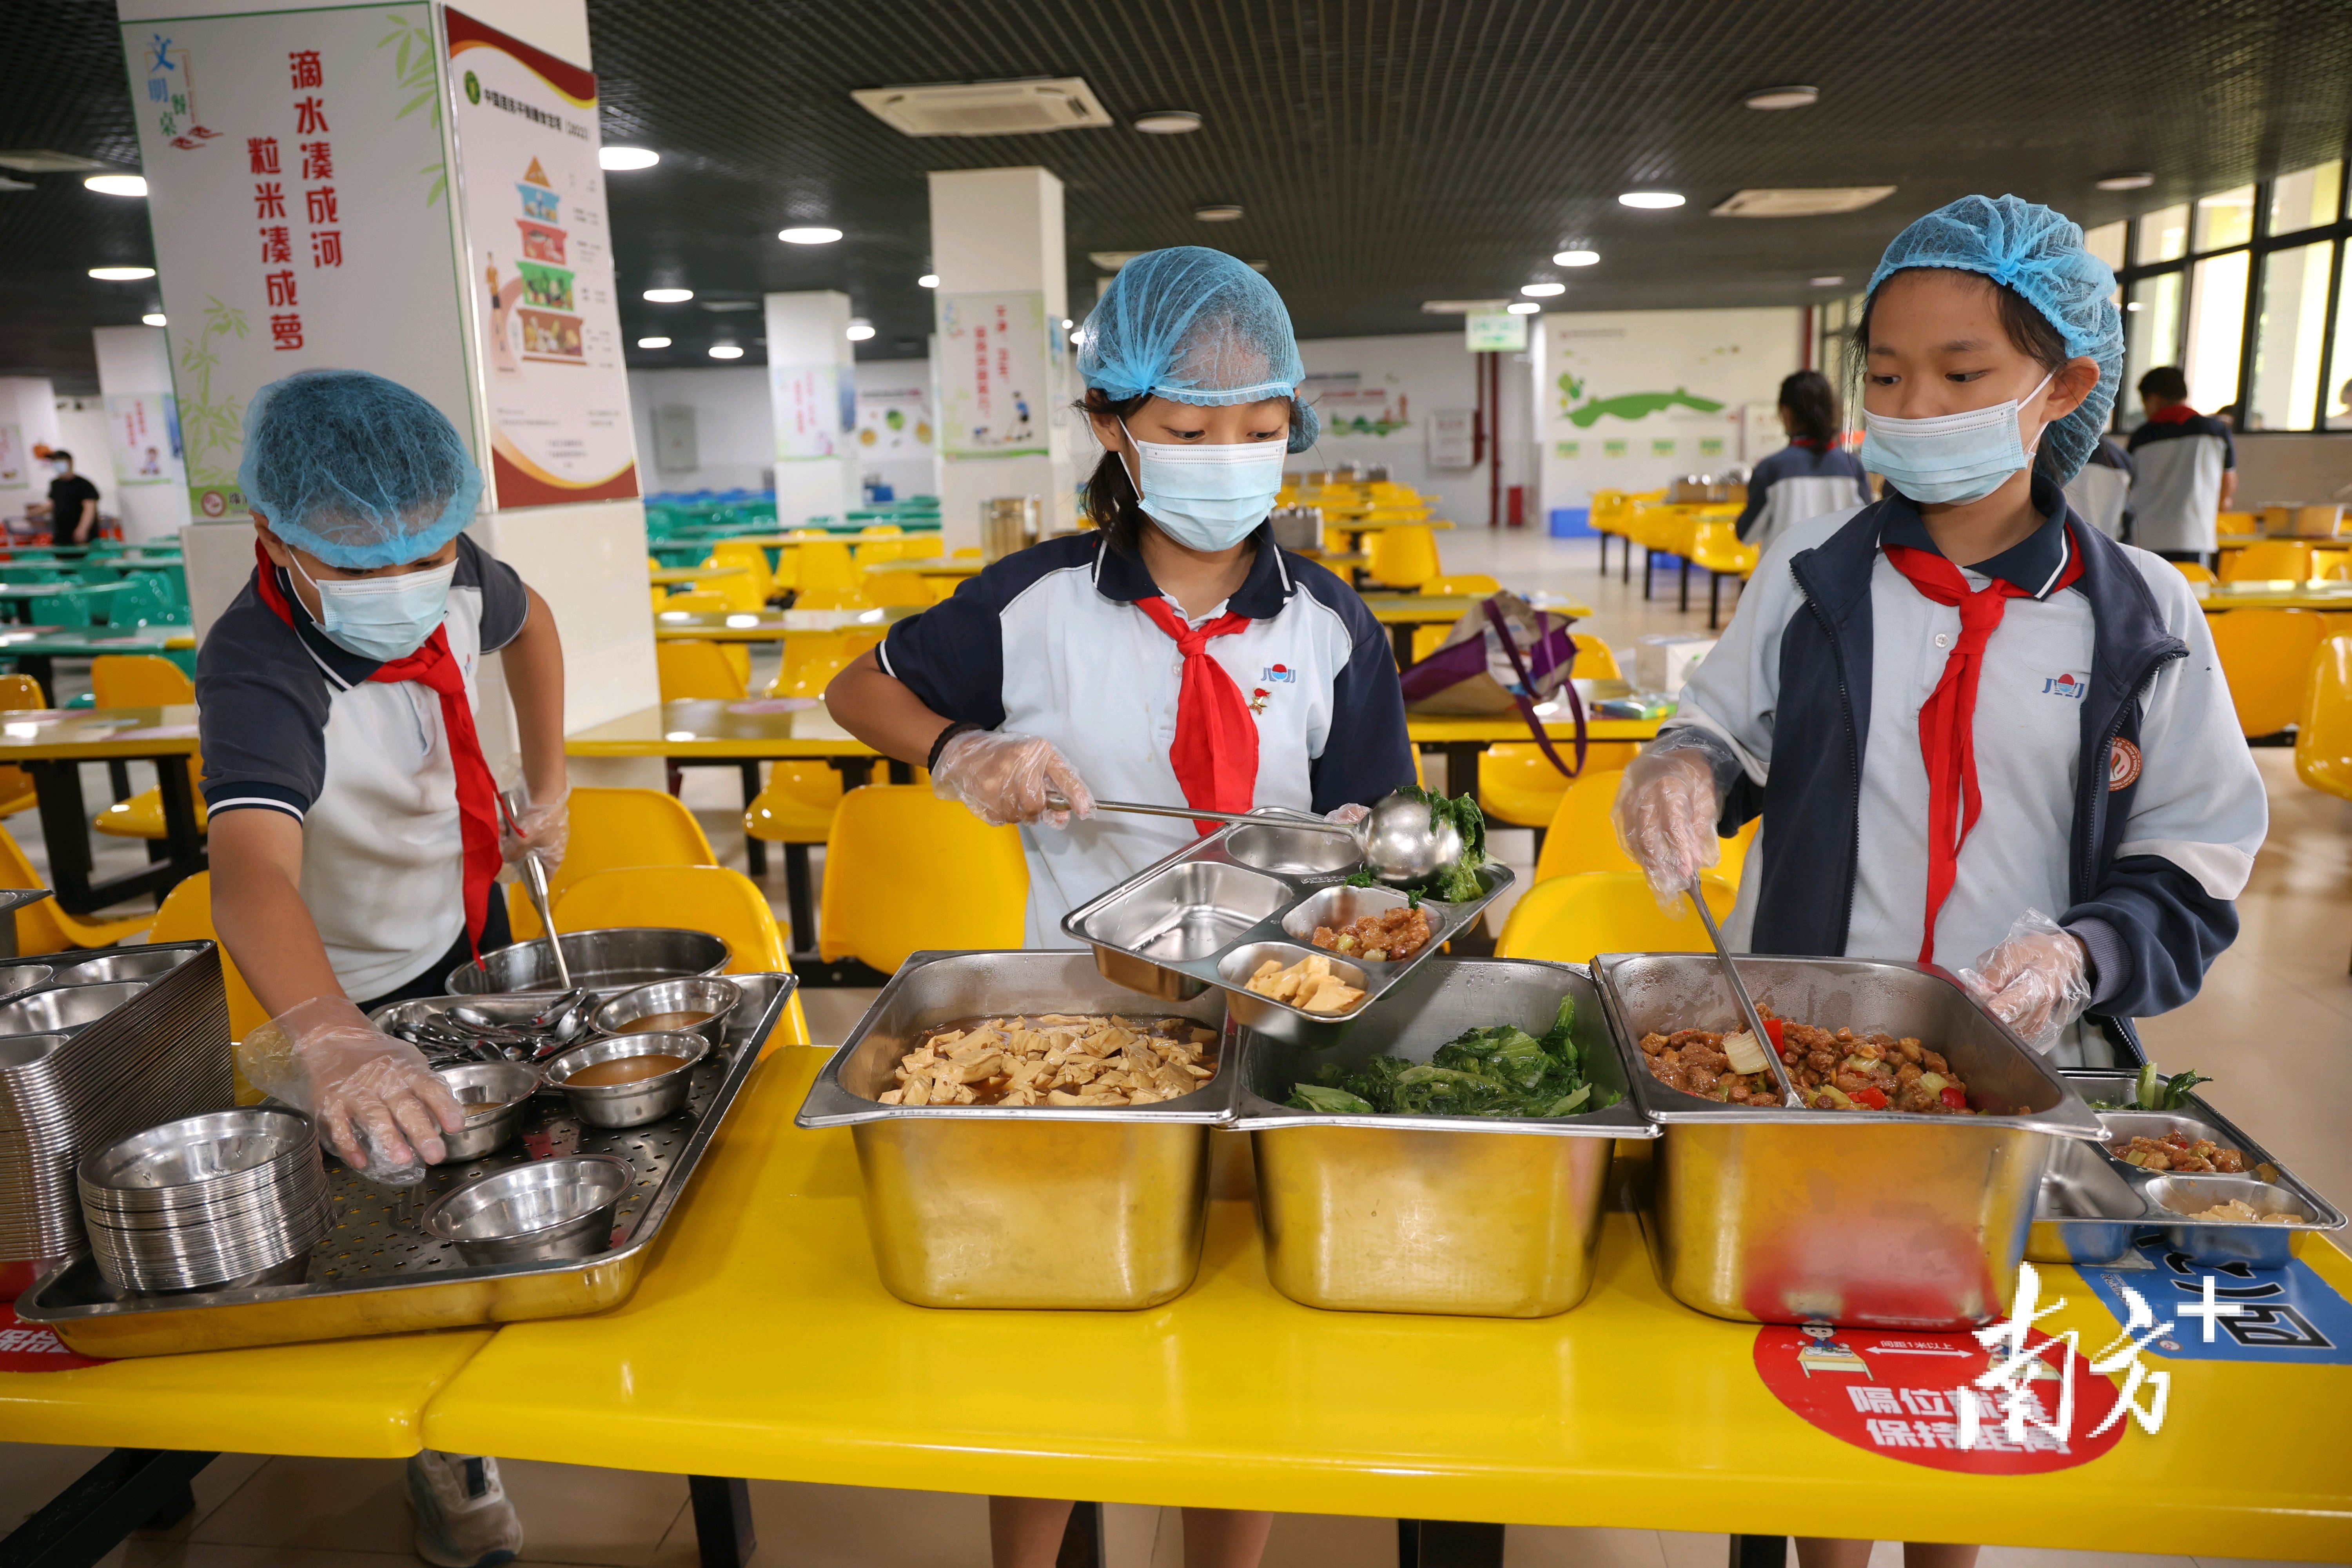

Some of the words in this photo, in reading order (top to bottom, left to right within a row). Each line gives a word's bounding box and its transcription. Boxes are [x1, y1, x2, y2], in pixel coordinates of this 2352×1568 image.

[247, 136, 304, 350] 粒米凑成萝
[288, 50, 343, 268] 滴水凑成河
[1880, 1340, 1954, 1350] 间距1米以上
